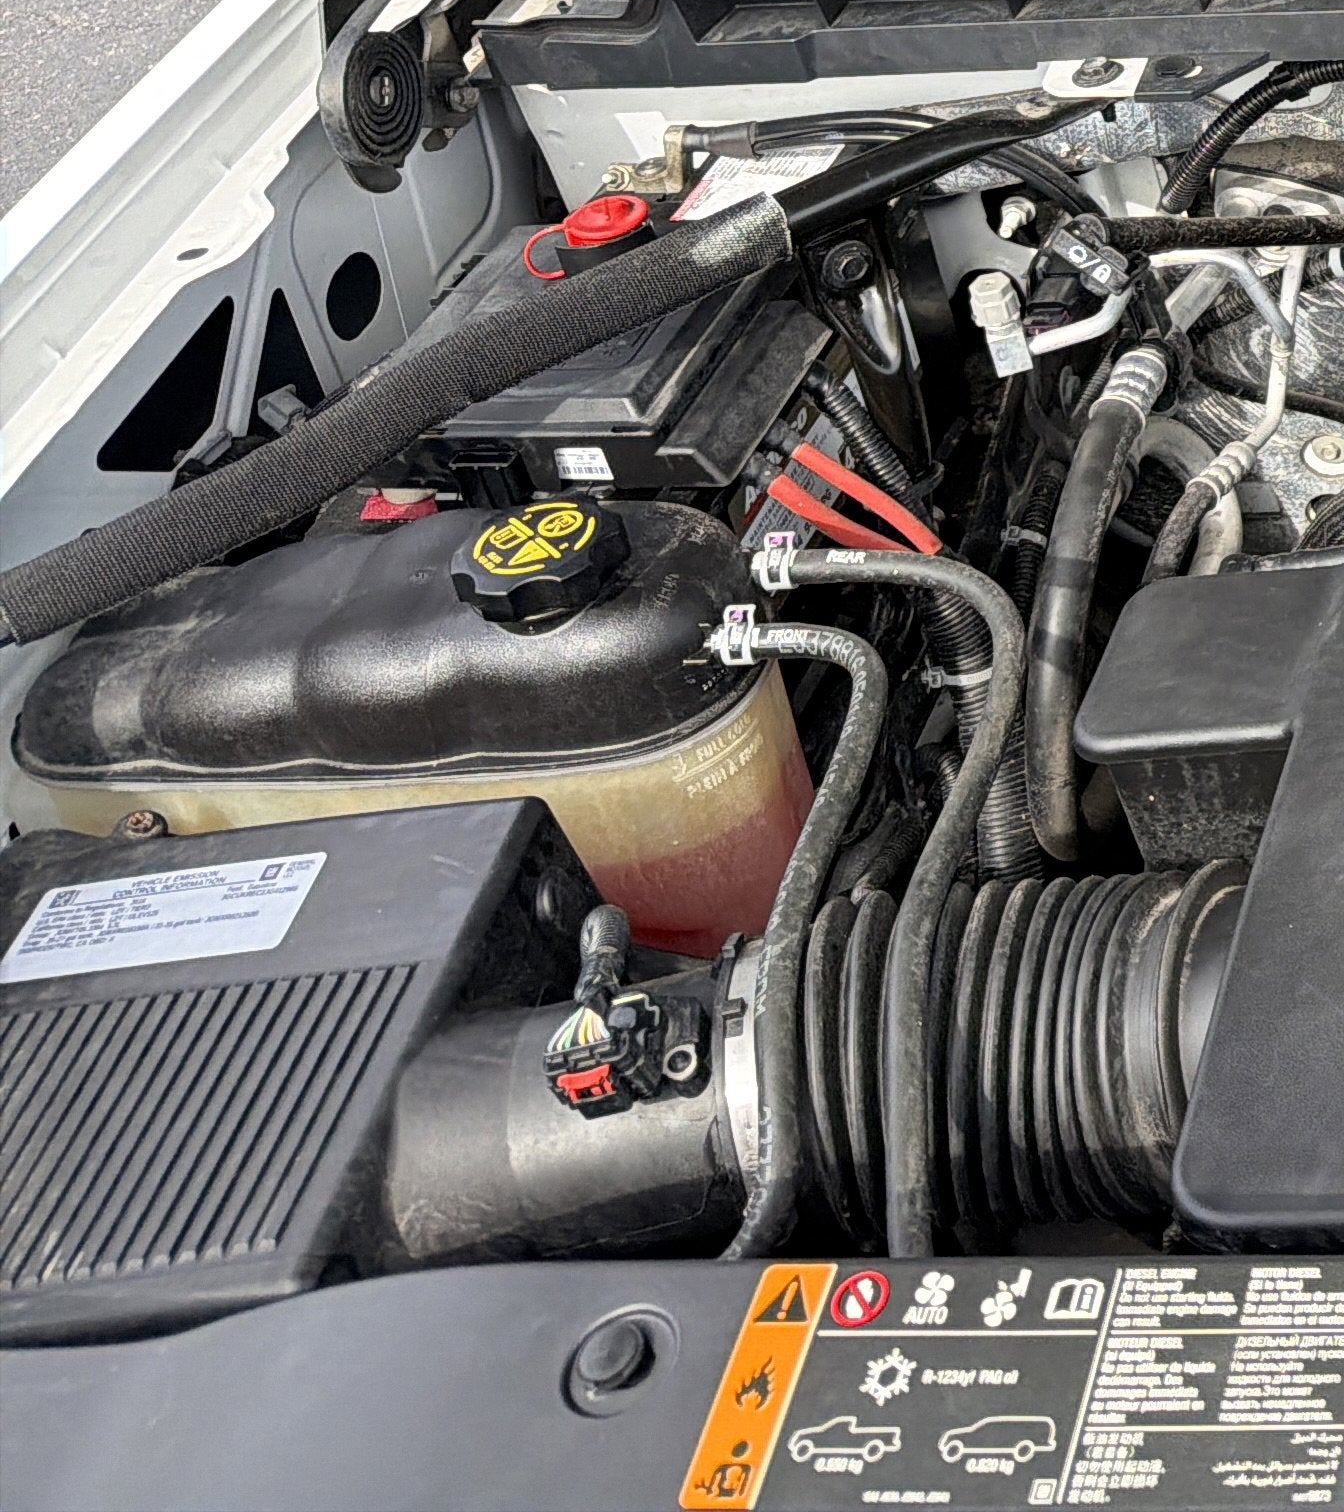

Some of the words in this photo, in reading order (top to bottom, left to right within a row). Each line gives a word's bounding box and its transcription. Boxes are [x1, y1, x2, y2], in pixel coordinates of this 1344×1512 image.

[826, 549, 867, 564] REAR
[767, 629, 810, 643] FRONT
[695, 736, 727, 762] FULL
[902, 1306, 949, 1324] AUTO
[849, 1457, 864, 1475] kg
[999, 1458, 1015, 1475] kg
